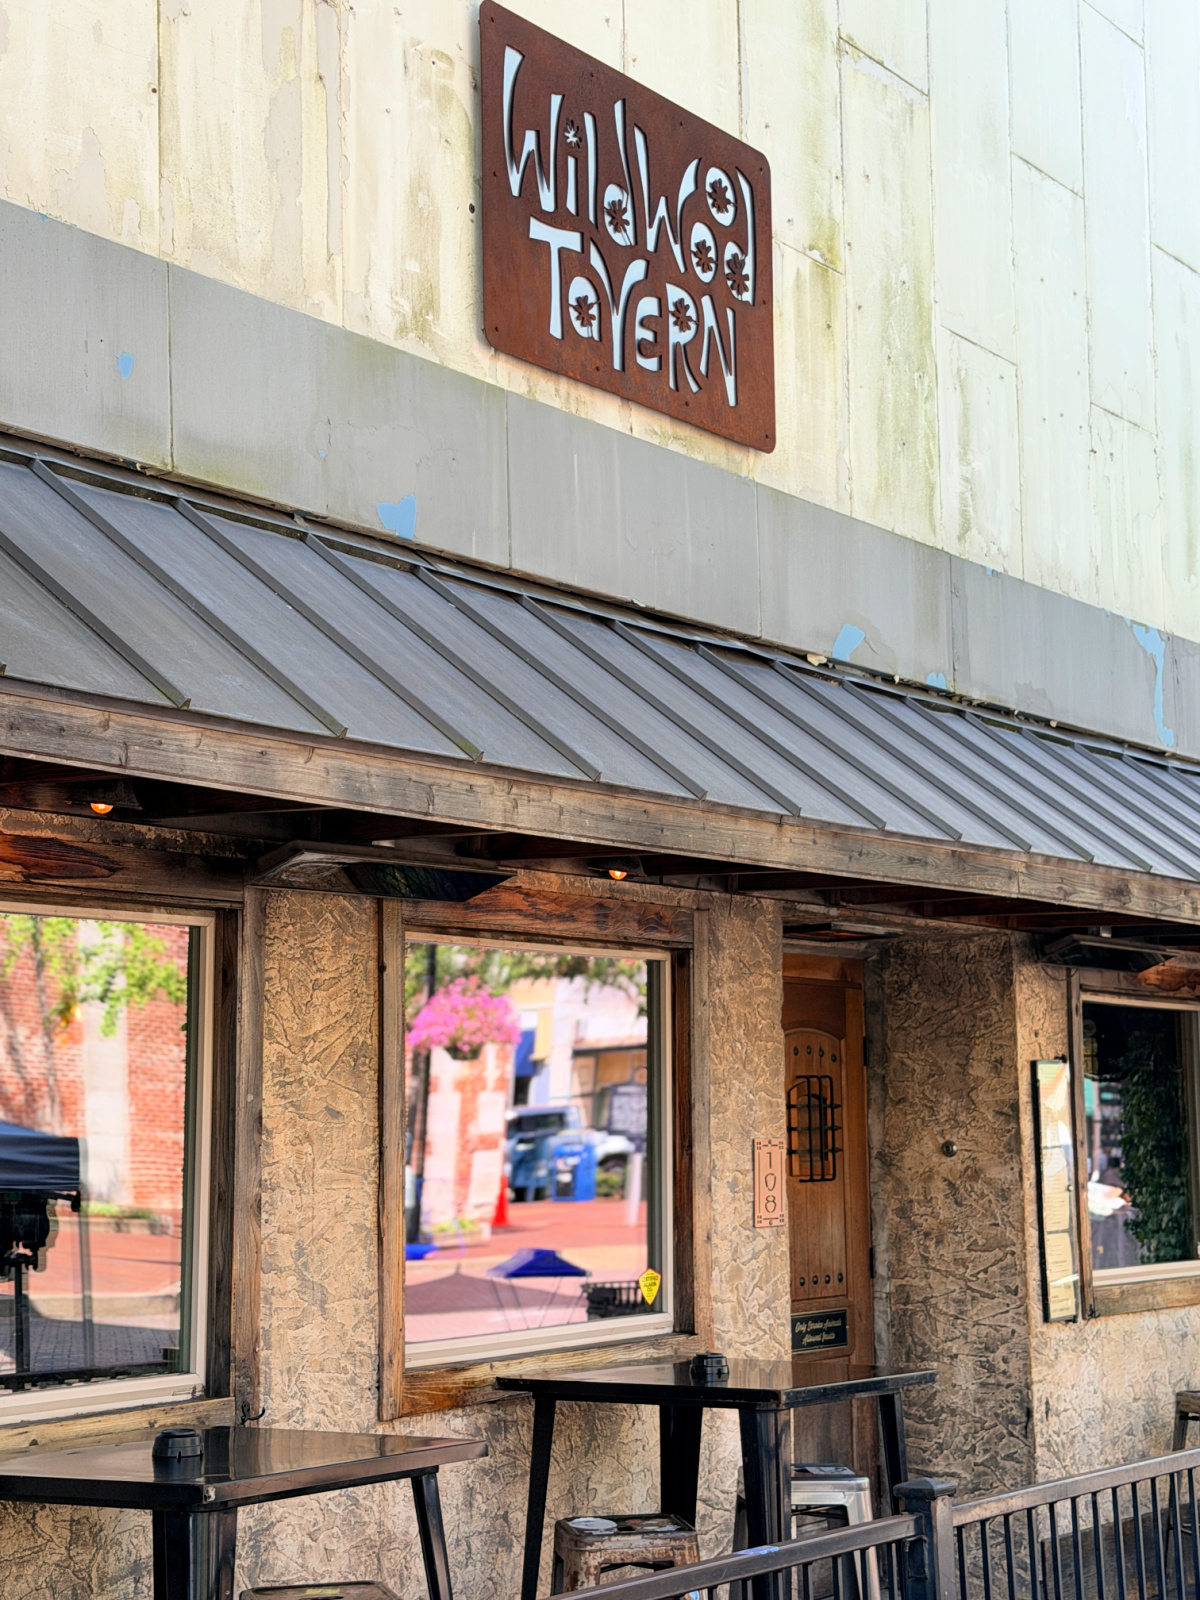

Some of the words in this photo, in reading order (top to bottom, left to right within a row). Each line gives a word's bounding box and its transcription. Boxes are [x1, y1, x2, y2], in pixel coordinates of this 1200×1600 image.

[764, 1151, 777, 1213] 108
[795, 1322, 807, 1333] Only
[807, 1320, 823, 1331] Service
[823, 1318, 841, 1330] Animals
[802, 1333, 821, 1346] Allowed
